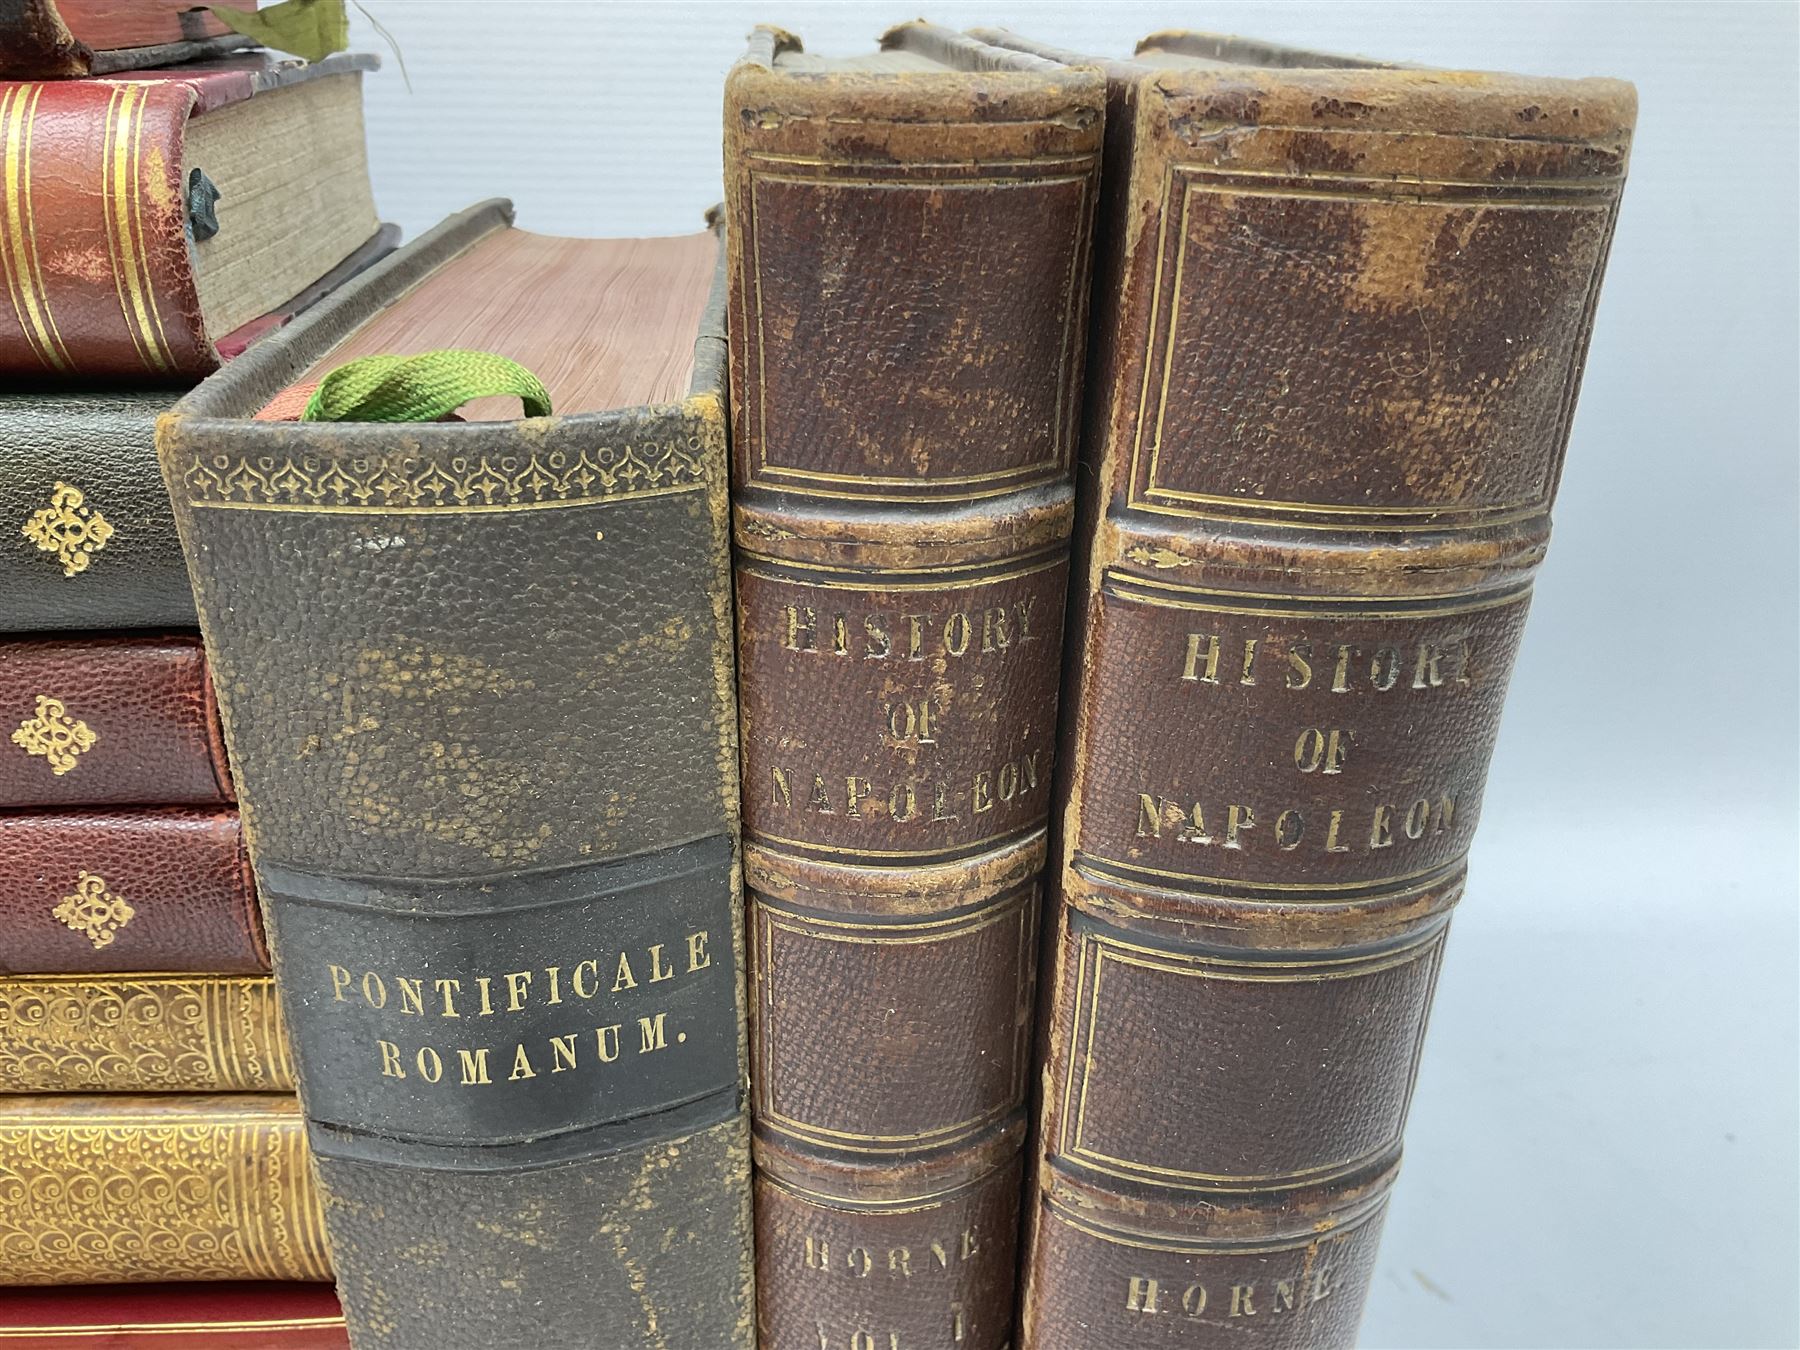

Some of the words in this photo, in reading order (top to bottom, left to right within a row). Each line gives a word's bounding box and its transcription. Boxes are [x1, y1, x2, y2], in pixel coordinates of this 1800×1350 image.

[785, 602, 1038, 661] HISTORY
[1181, 633, 1473, 693] HISTORY
[886, 700, 942, 744] OF
[1294, 728, 1355, 774] OF
[770, 749, 1041, 822] NAPOLEON
[1136, 793, 1459, 852] NAPOLEON
[328, 930, 711, 1018] PONTIFICALE
[377, 1013, 687, 1085] ROMANUM.
[805, 1225, 977, 1279] HORNE
[1126, 1268, 1332, 1317] HORNE
